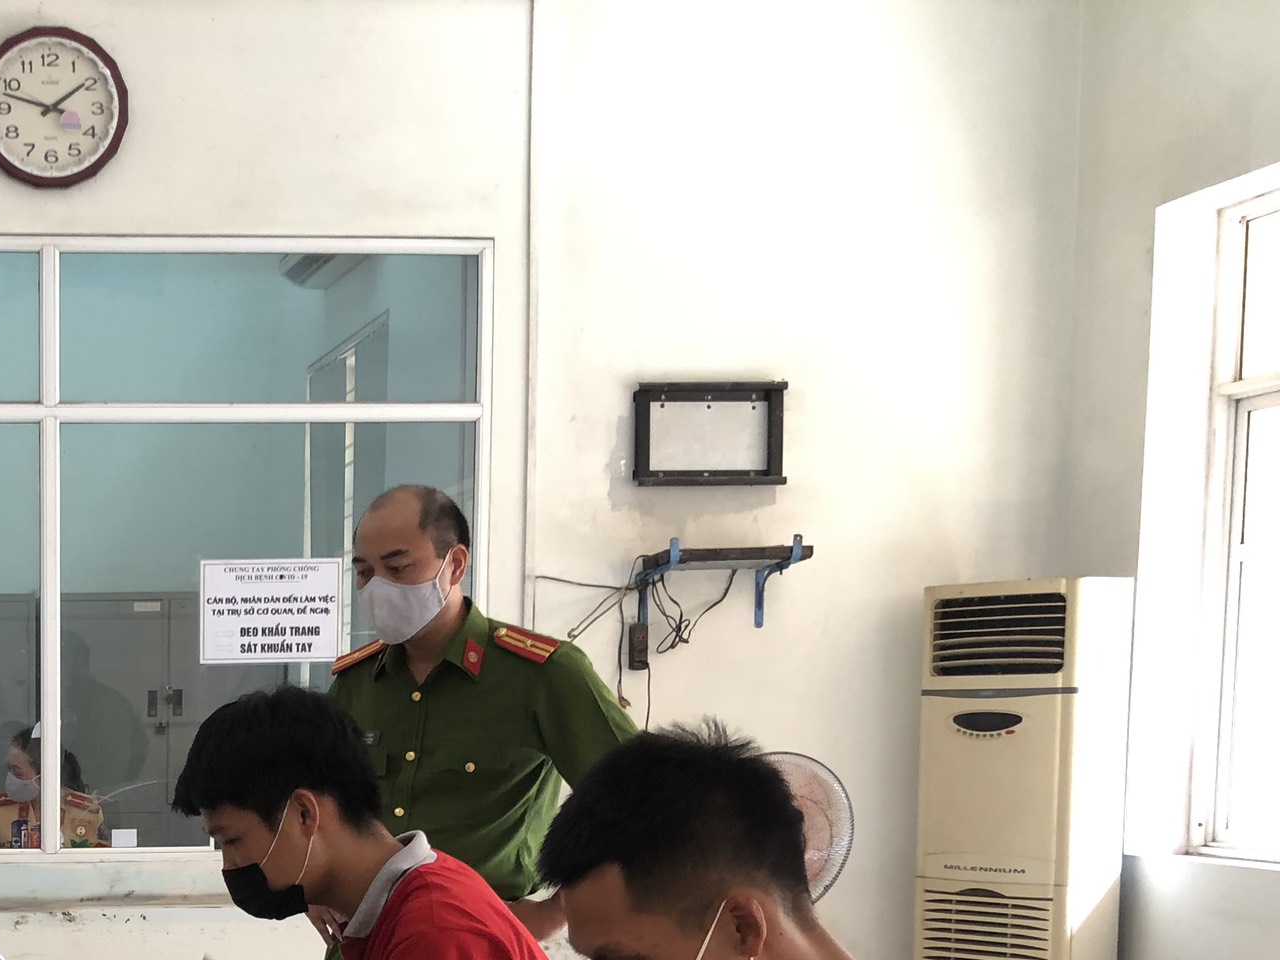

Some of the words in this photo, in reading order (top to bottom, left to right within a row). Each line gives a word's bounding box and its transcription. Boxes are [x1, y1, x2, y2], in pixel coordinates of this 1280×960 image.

[21, 60, 32, 73] 11
[41, 53, 59, 67] 12
[72, 60, 75, 73] 1
[3, 78, 21, 91] 10
[84, 78, 97, 91] 2
[92, 102, 104, 115] 3
[5, 126, 19, 139] 8
[82, 125, 96, 138] 4
[24, 144, 35, 157] 7
[44, 151, 58, 163] 6
[68, 144, 81, 157] 5
[207, 596, 223, 605] CÁN
[241, 596, 261, 604] NHÂN
[263, 596, 281, 604] DÂN
[282, 595, 299, 604] ĐẾN
[319, 594, 336, 603] VIỆC
[211, 608, 224, 618] TẠI
[226, 608, 242, 617] TRỤ
[257, 607, 270, 616] CƠ
[240, 627, 258, 637] ĐEO
[290, 626, 320, 636] TRANG
[240, 642, 257, 654] SÁT
[295, 642, 312, 653] TAY
[943, 864, 1026, 874] MILLENNIUM
